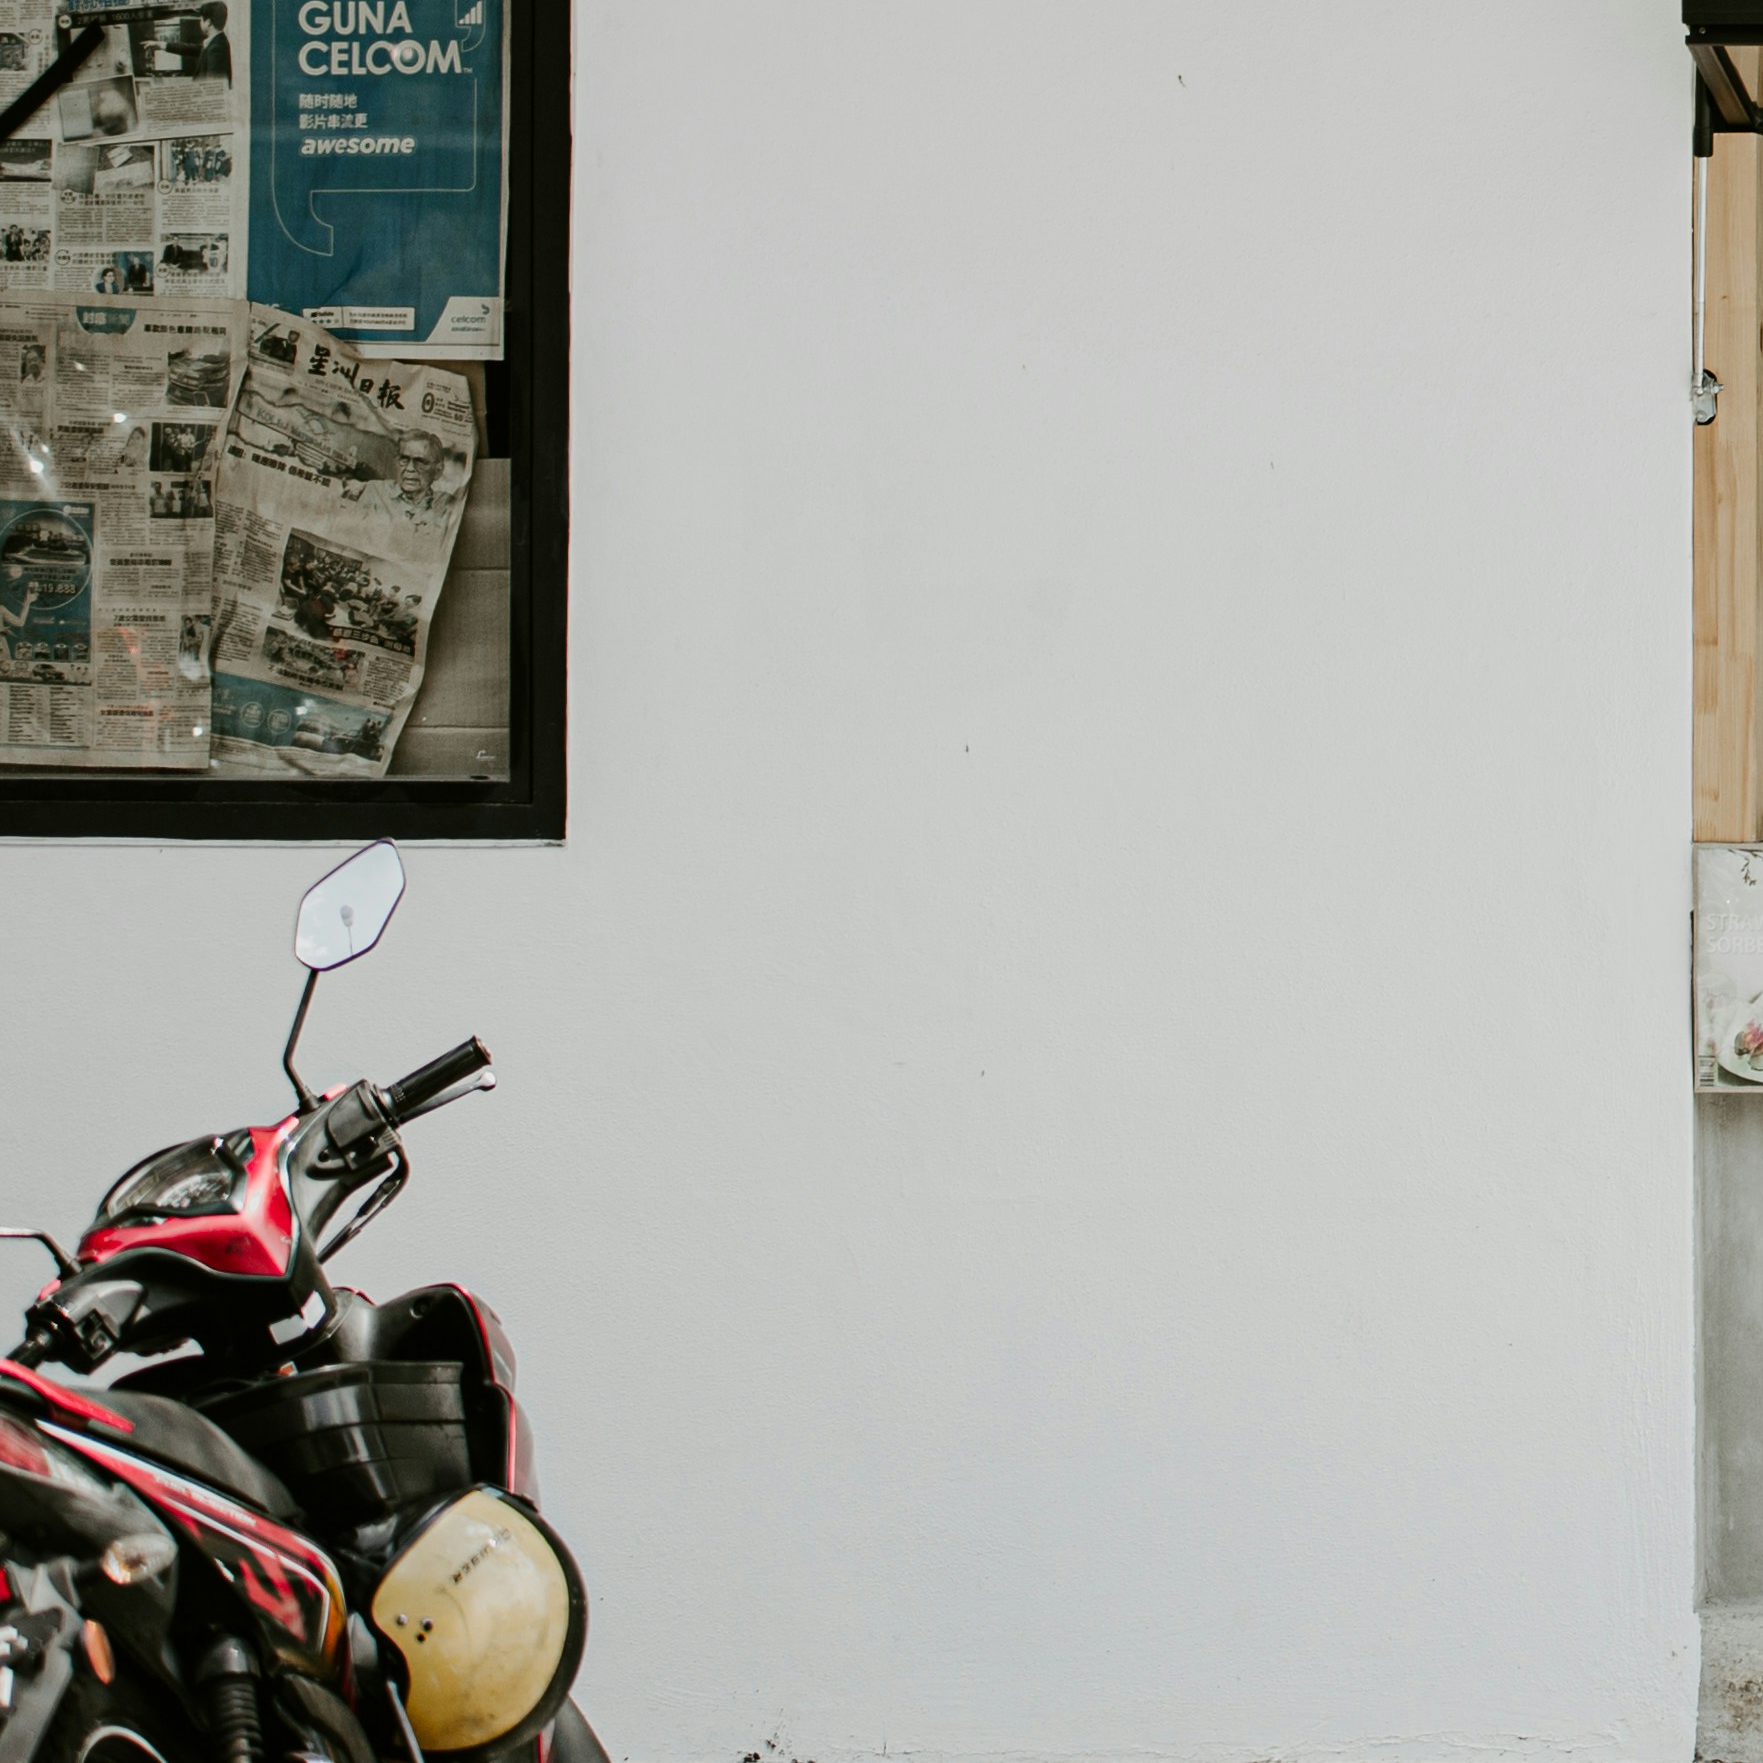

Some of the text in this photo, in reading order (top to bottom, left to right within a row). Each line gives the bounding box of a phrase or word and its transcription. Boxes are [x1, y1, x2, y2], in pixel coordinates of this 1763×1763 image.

[298, 0, 413, 35] GUNA
[298, 39, 462, 76] CELCOM
[299, 93, 357, 109] 随时随地
[301, 137, 416, 155] awesome
